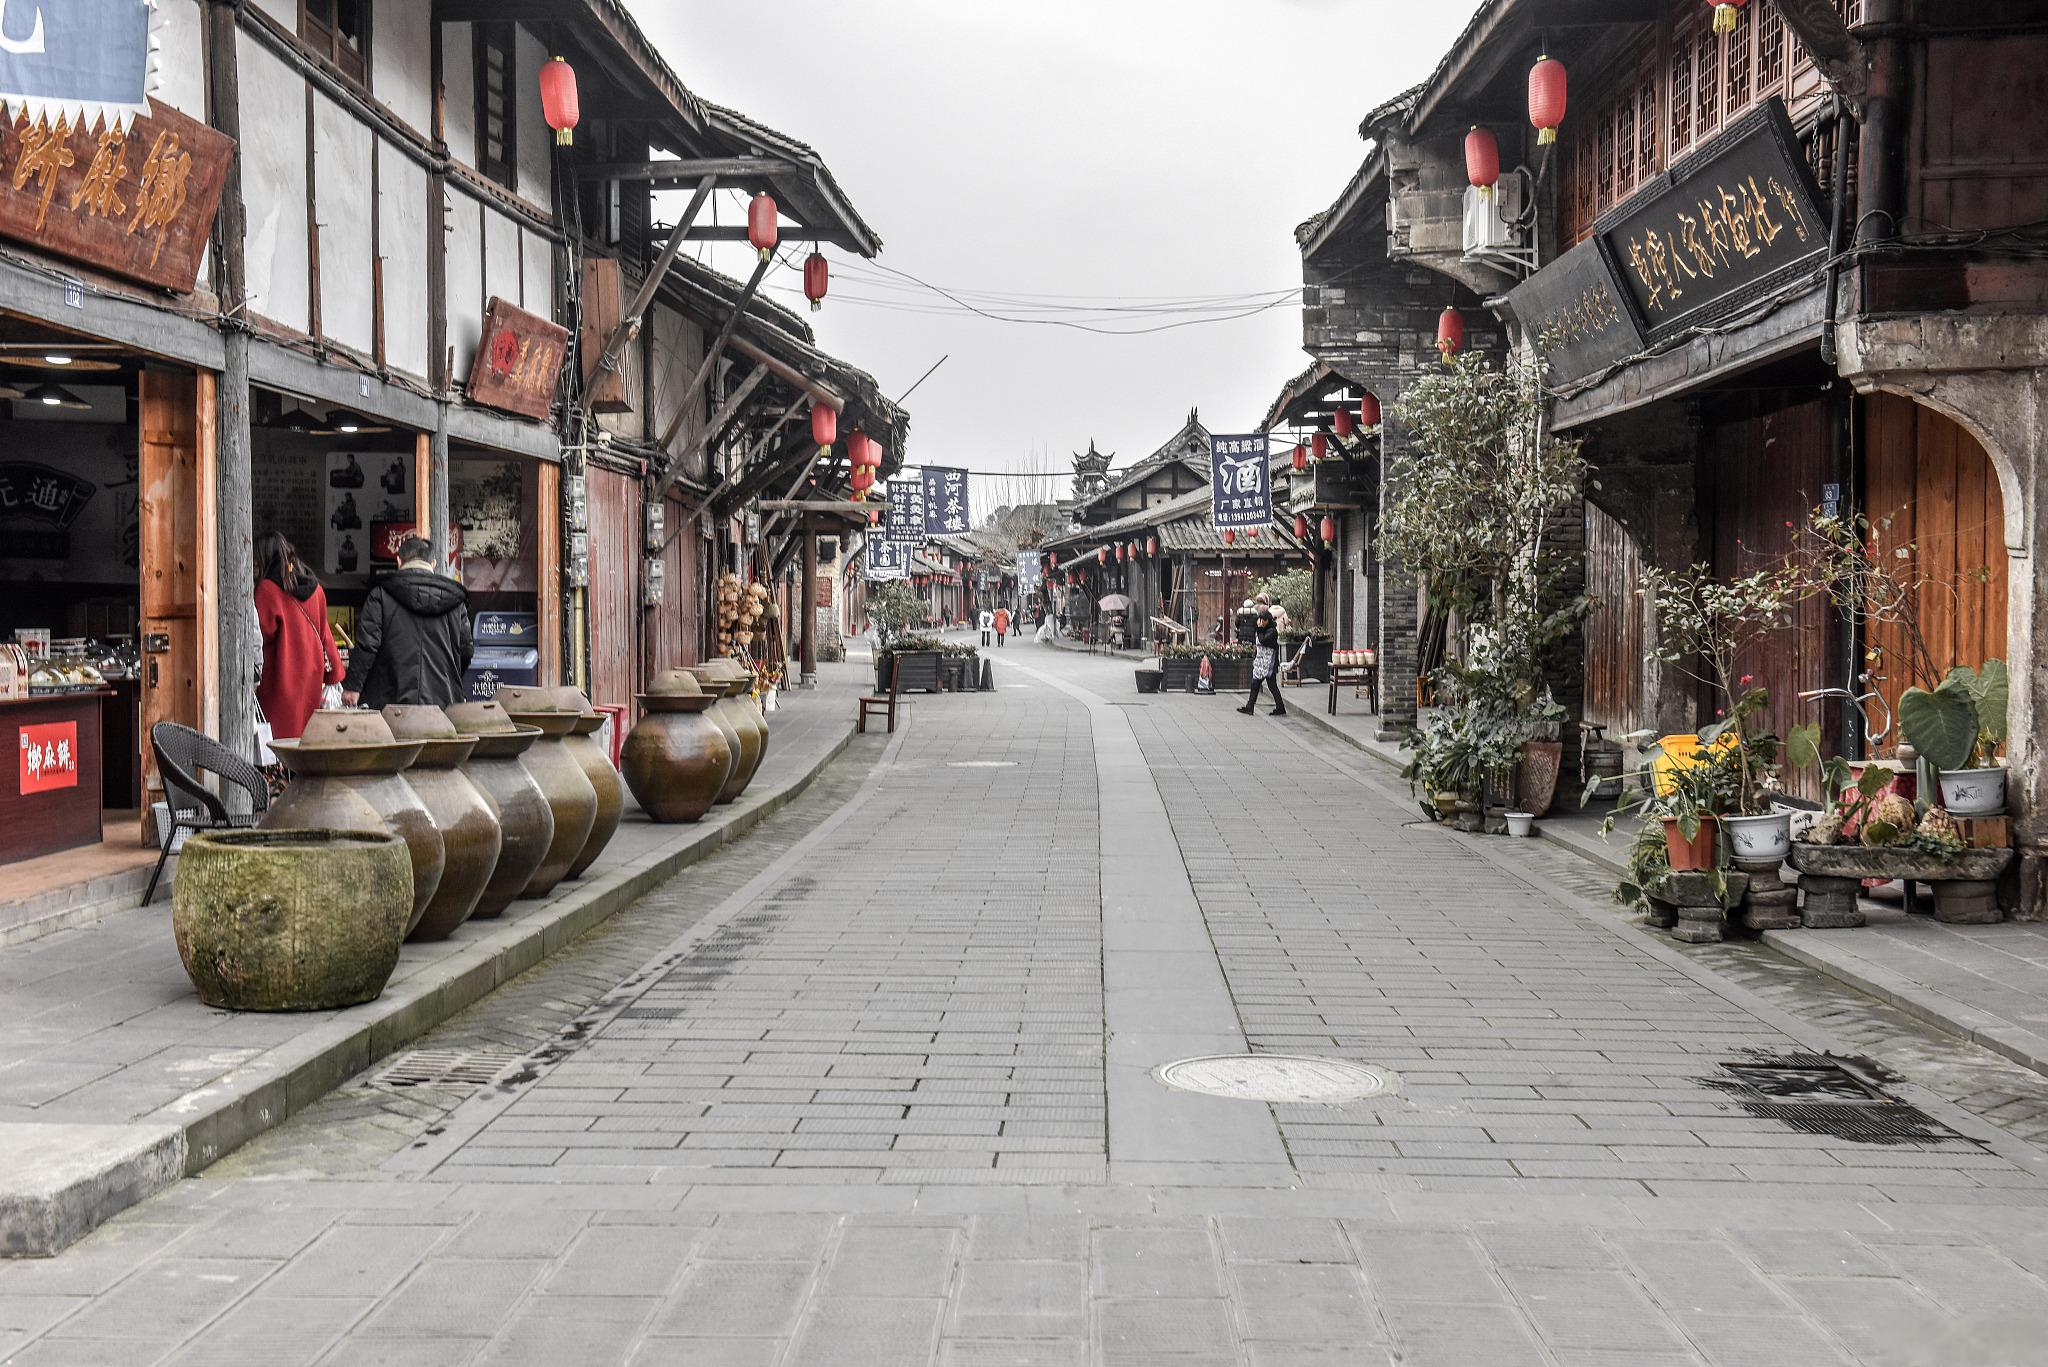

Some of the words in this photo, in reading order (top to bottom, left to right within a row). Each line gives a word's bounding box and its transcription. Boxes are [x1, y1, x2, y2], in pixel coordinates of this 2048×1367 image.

[1219, 455, 1264, 494] 酒
[1220, 496, 1263, 510] 厂家直销
